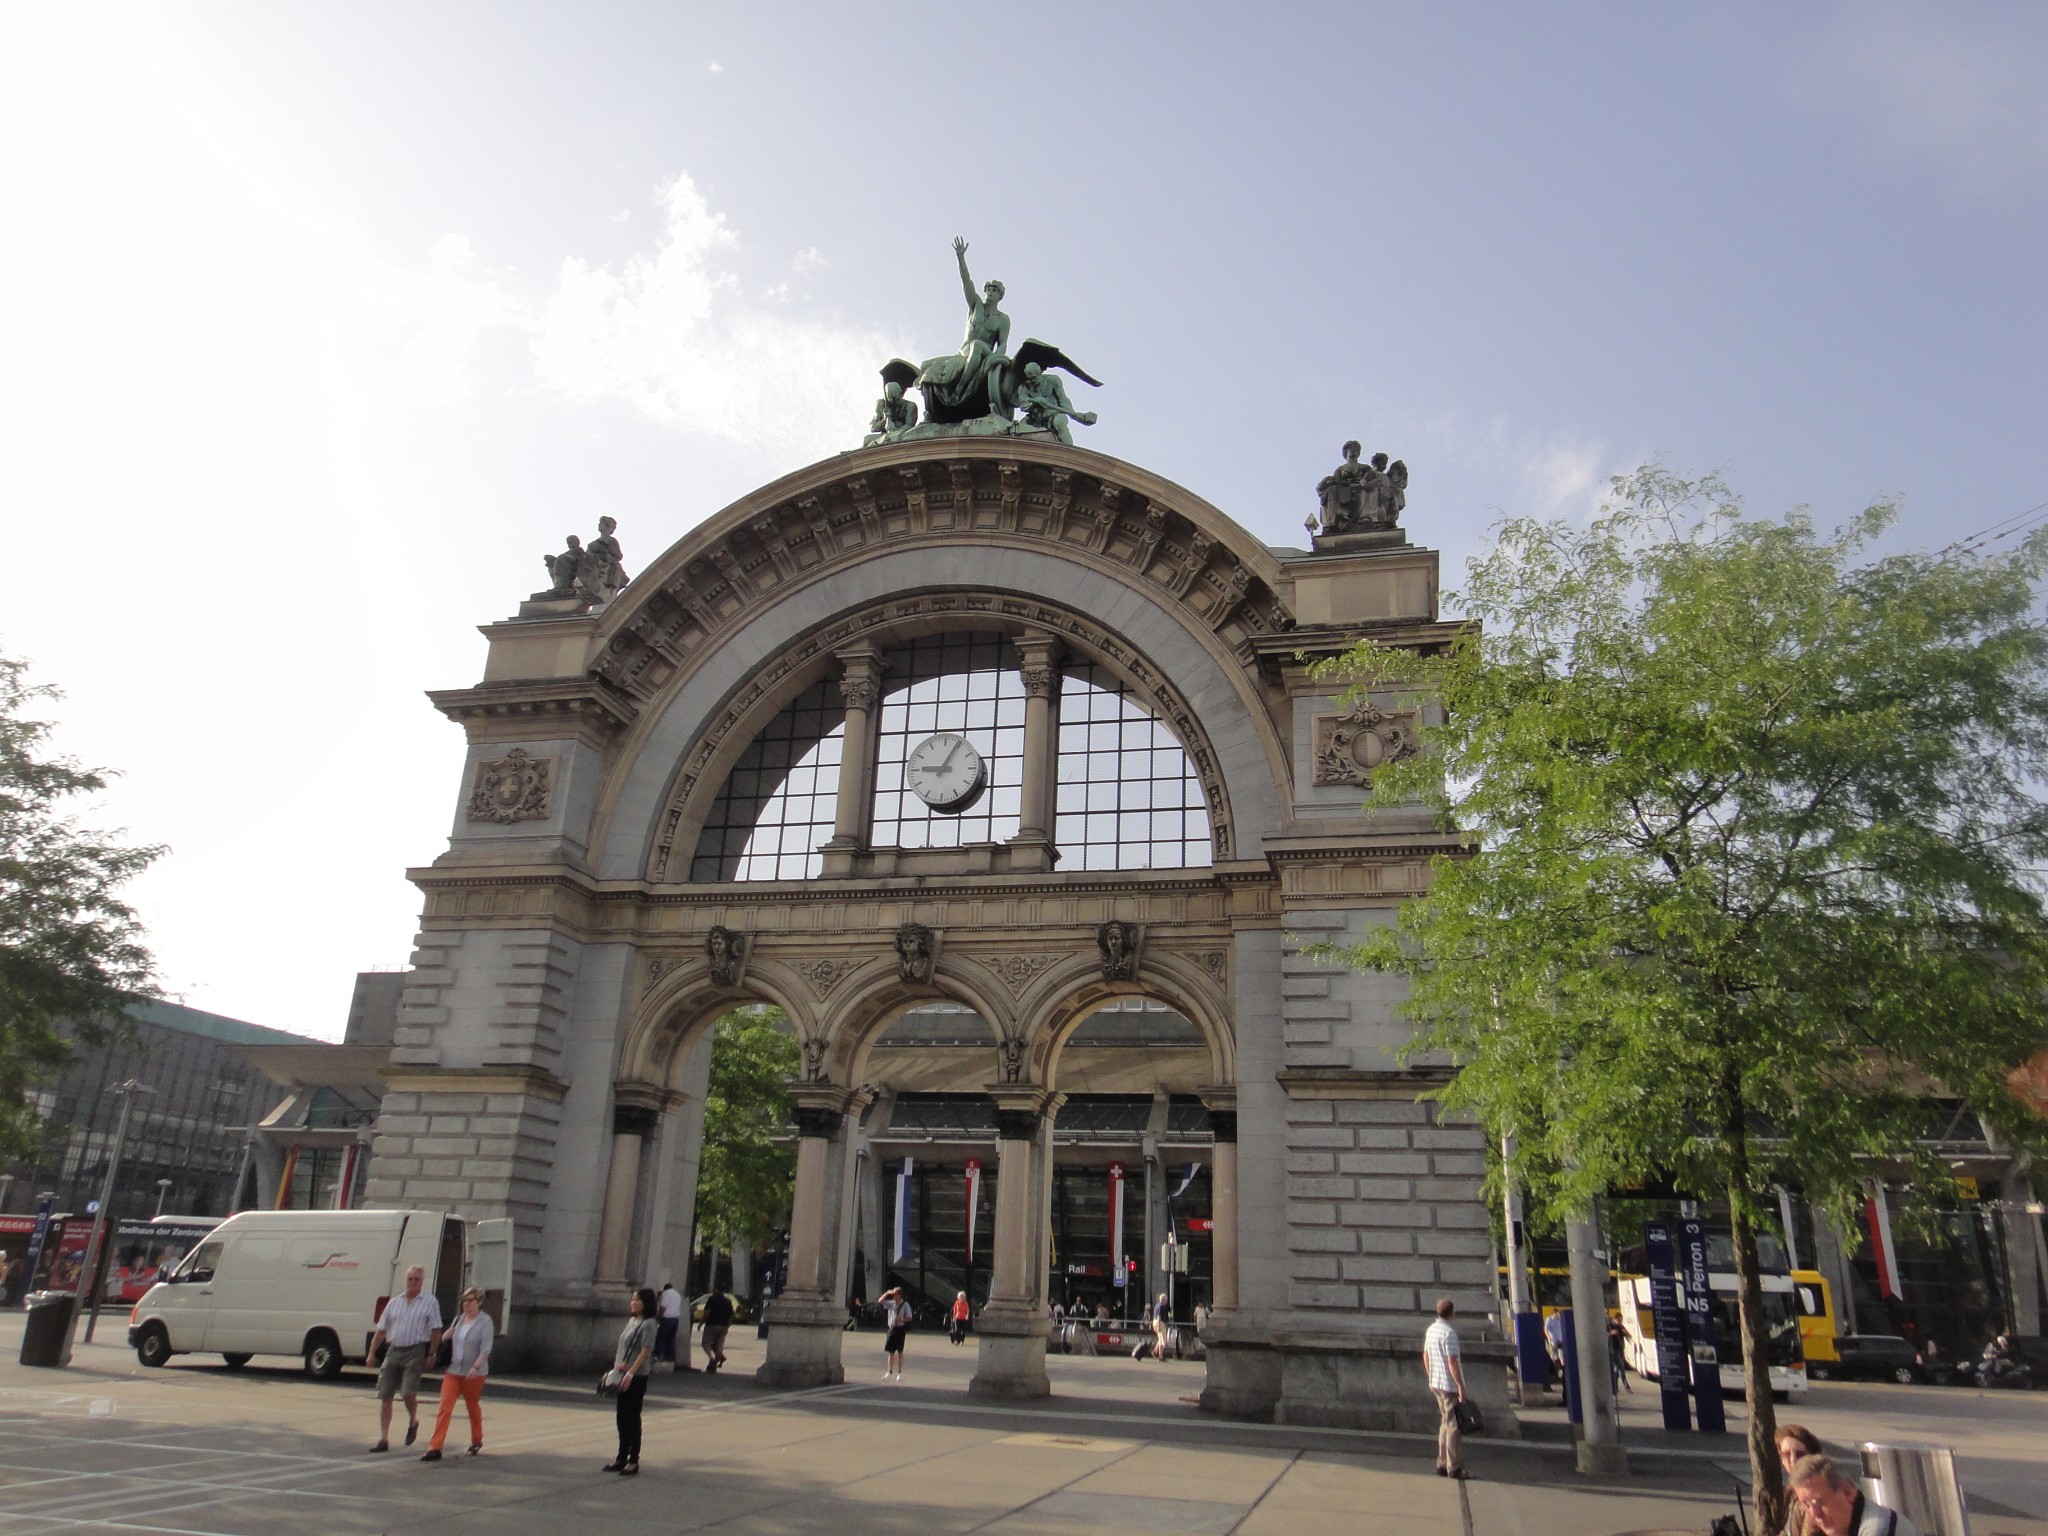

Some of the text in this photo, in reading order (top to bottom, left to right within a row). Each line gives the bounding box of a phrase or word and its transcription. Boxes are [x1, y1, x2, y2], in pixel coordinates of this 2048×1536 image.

[156, 1227, 170, 1236] der
[1685, 1223, 1705, 1292] Perron 3
[1687, 1297, 1709, 1312] N5
